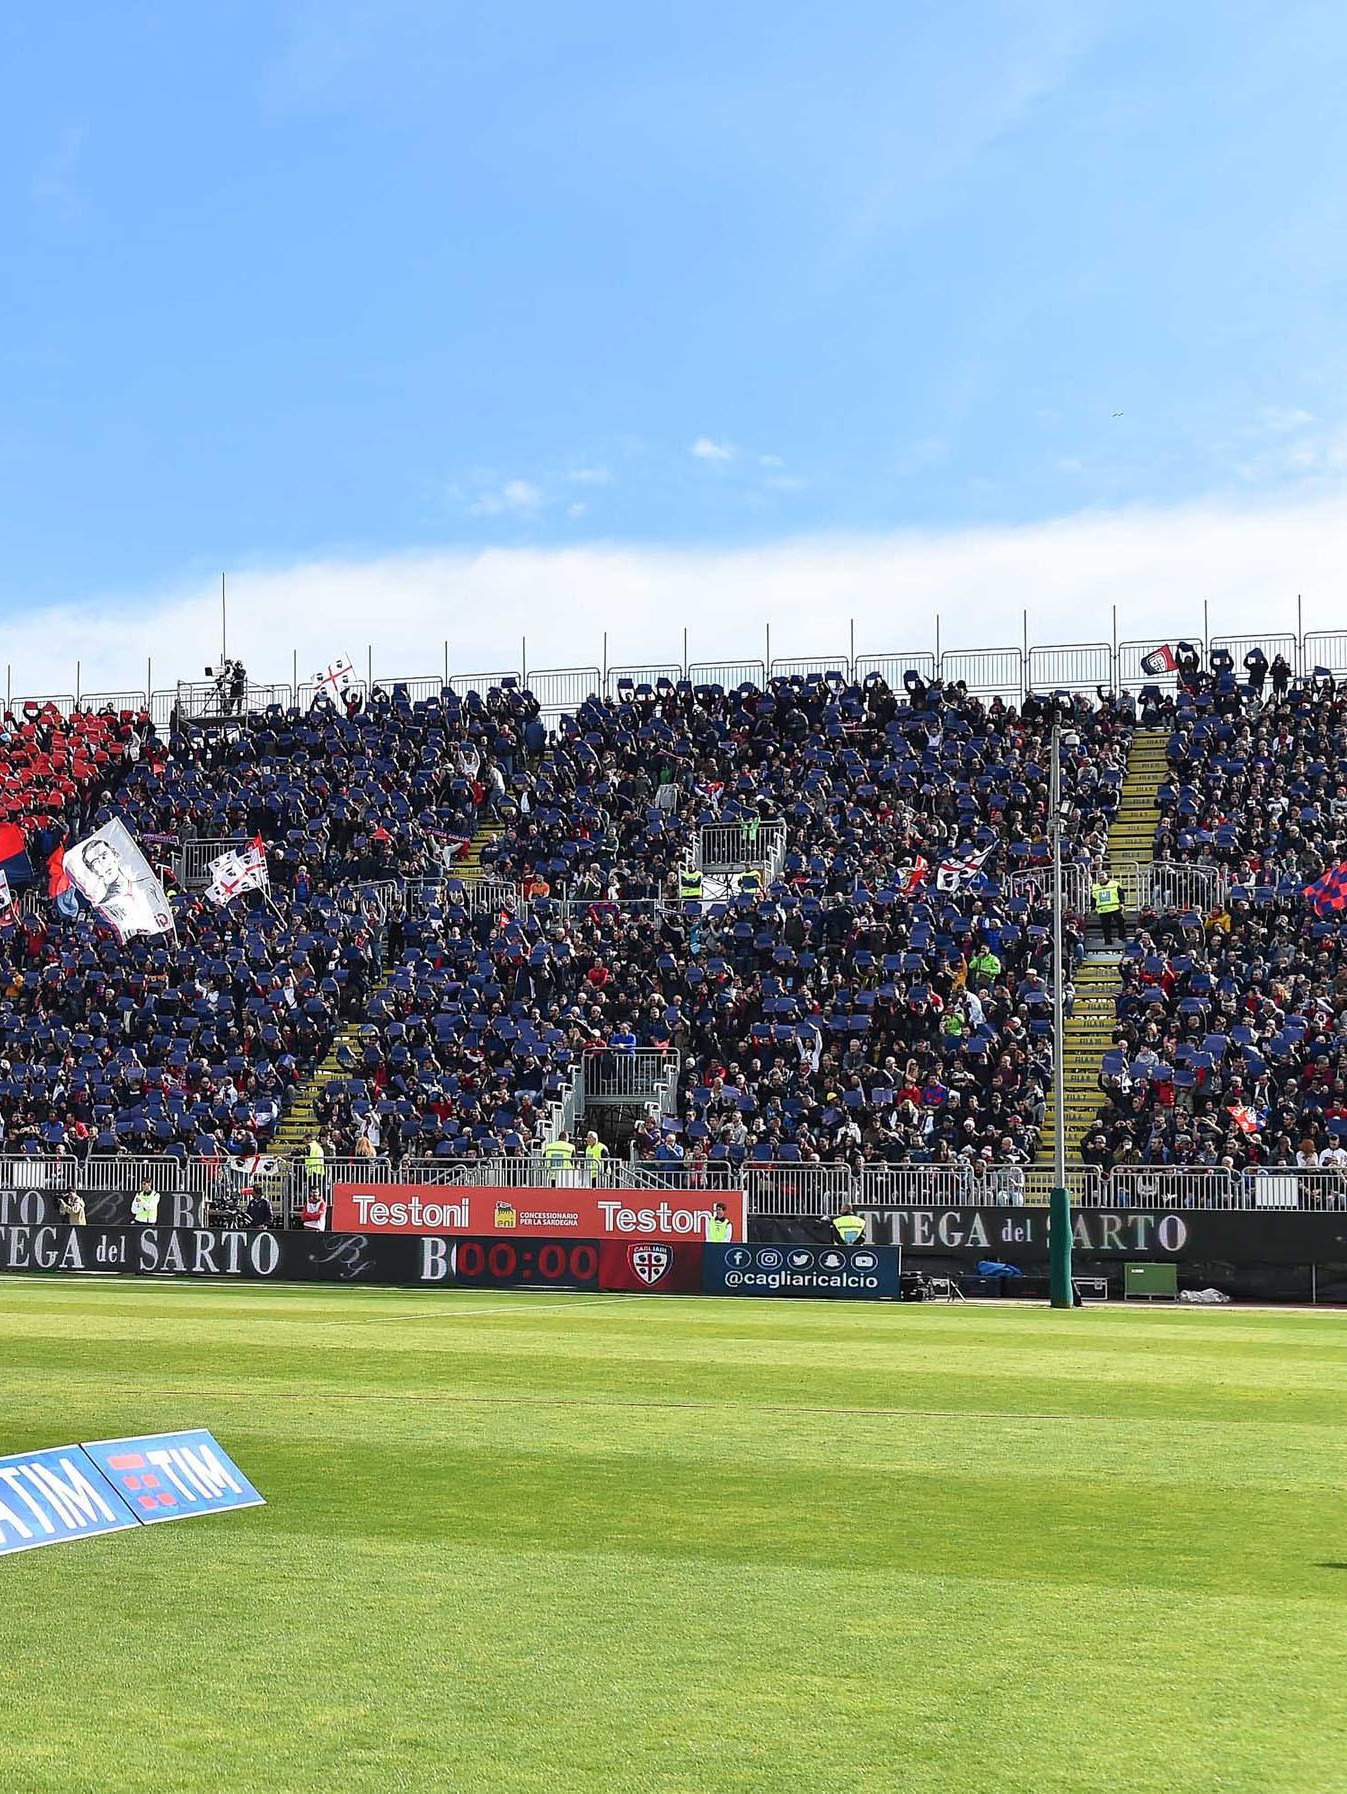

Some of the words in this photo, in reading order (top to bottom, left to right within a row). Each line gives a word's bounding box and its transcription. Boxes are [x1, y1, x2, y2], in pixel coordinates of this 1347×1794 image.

[172, 1193, 202, 1228] B
[352, 1194, 471, 1228] Testoni
[497, 1217, 514, 1228] eni
[519, 1212, 579, 1220] CONCESSIONARIO
[1002, 1219, 1032, 1242] del
[1046, 1214, 1187, 1251] ARTO
[96, 1234, 126, 1263] del
[139, 1230, 280, 1275] SARTO
[458, 1242, 598, 1280] 00:00
[724, 1271, 878, 1289] @cagliaricalcio
[153, 1447, 240, 1502] TIM
